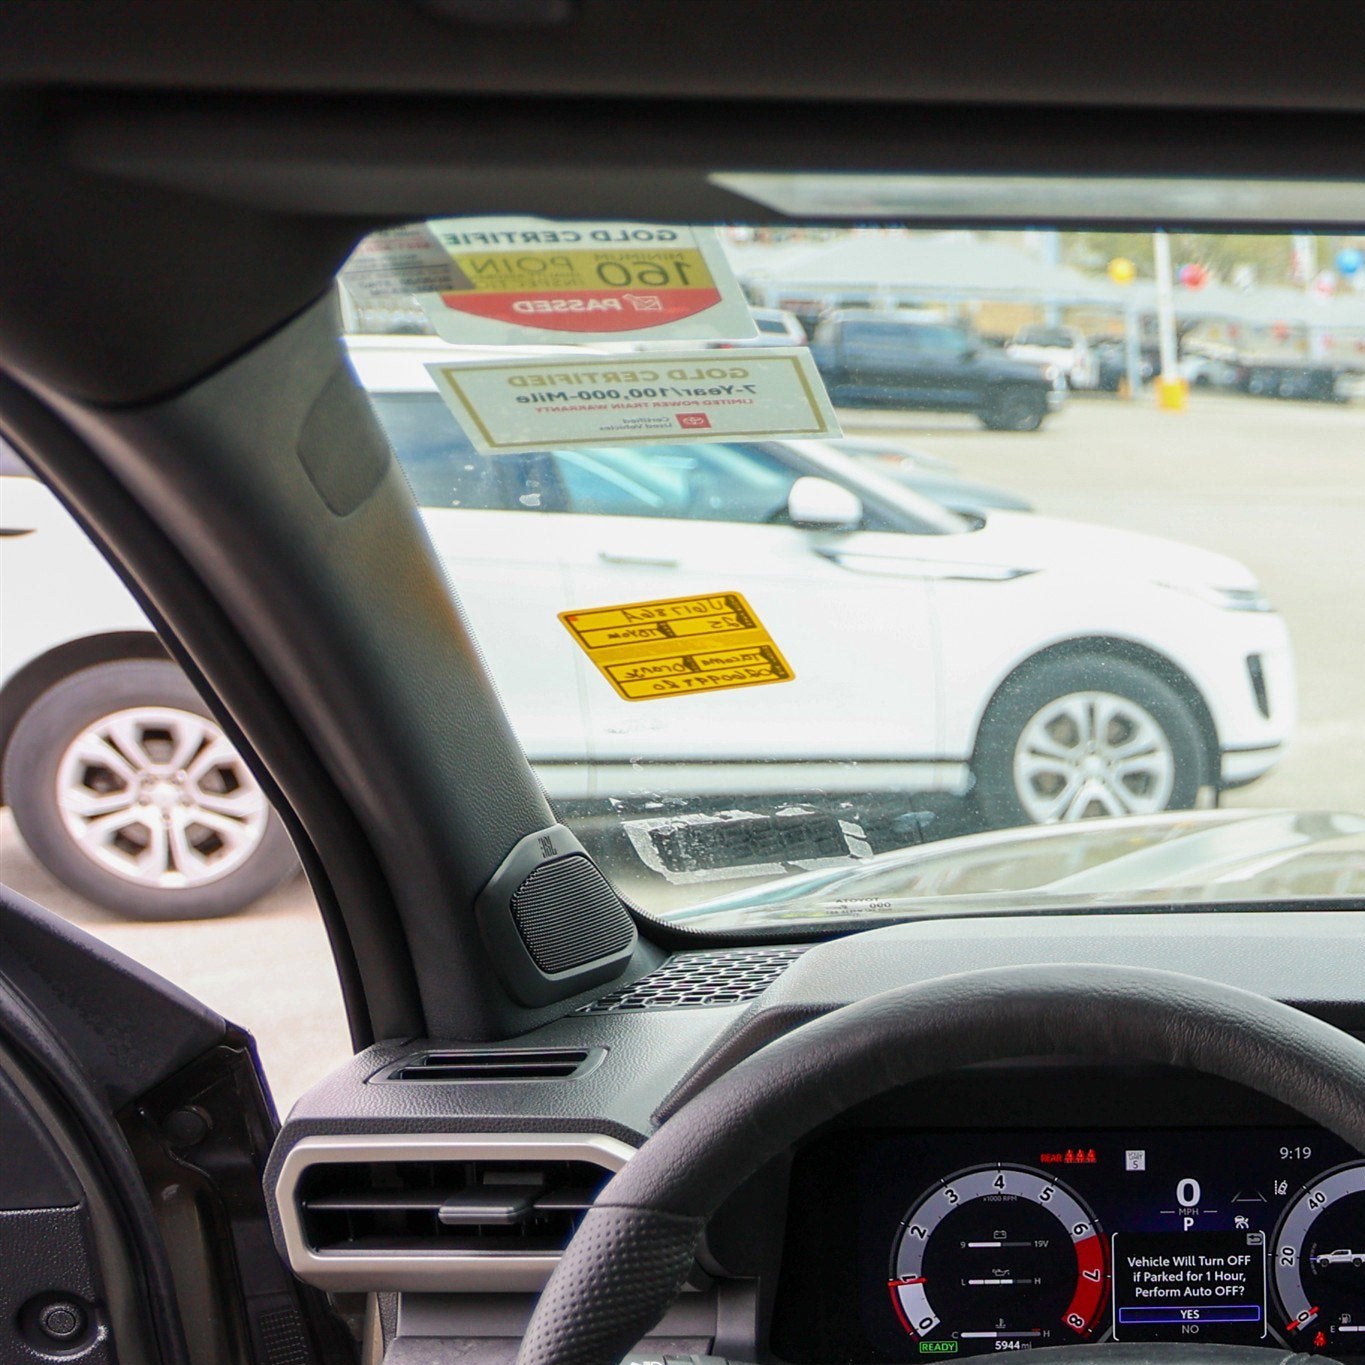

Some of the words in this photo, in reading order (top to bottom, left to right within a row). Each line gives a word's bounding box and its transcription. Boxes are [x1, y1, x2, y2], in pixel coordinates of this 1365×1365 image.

[1279, 1146, 1312, 1160] 9:19
[993, 1174, 1005, 1190] 4
[944, 1188, 960, 1204] 3
[1039, 1186, 1055, 1202] 5
[1175, 1178, 1201, 1207] 0
[1307, 1191, 1327, 1211] 40
[1178, 1207, 1200, 1216] MPH
[1072, 1222, 1089, 1238] 6
[1183, 1217, 1195, 1232] P
[910, 1225, 928, 1240] 2
[1034, 1240, 1049, 1249] 19V
[1127, 1256, 1170, 1267] Vehicle
[1172, 1255, 1196, 1267] Will
[1198, 1255, 1224, 1267] Turn
[1226, 1254, 1251, 1266] OFF
[1280, 1246, 1296, 1267] 20
[1083, 1268, 1101, 1283] 7
[1133, 1271, 1142, 1283] if
[1143, 1271, 1183, 1283] Parked
[1186, 1271, 1204, 1282] for
[1205, 1270, 1211, 1281] 1
[1214, 1270, 1247, 1283] Hour,
[1135, 1286, 1181, 1298] Perform
[1183, 1285, 1212, 1297] Auto
[1214, 1285, 1245, 1296] OFF?
[1067, 1313, 1085, 1329] 8
[1180, 1309, 1200, 1319] YES
[919, 1315, 934, 1330] 0
[1181, 1325, 1200, 1334] NO
[921, 1342, 955, 1352] READY
[994, 1340, 1020, 1350] 5944
